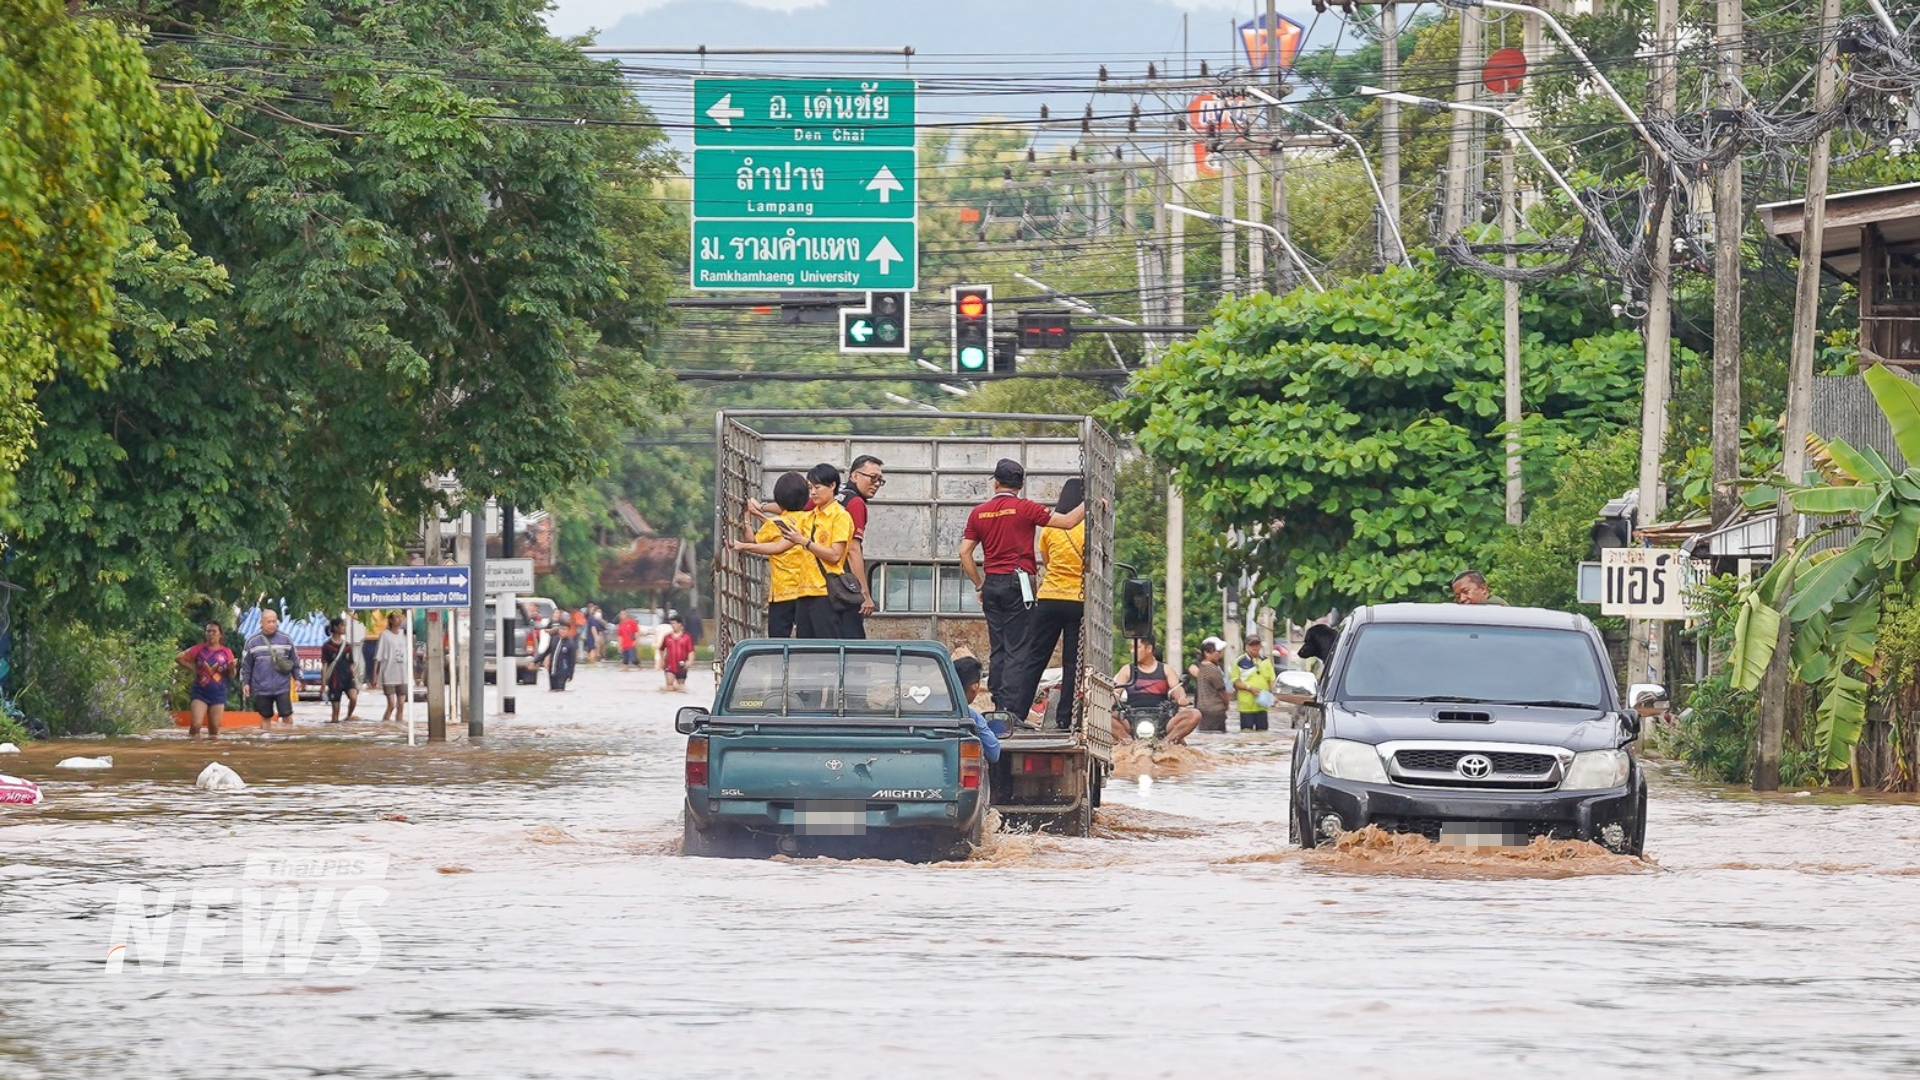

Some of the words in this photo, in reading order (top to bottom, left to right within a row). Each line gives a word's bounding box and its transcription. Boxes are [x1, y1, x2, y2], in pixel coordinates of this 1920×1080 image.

[769, 95, 792, 119] อ.
[804, 82, 890, 119] เด่นชัย
[794, 128, 822, 141] Den
[832, 128, 865, 141] Chai
[737, 157, 824, 191] ลำปาง
[747, 200, 814, 215] Lampang
[700, 235, 725, 260] ม.
[729, 228, 860, 260] รามคำแหง
[700, 269, 795, 285] Ramkhamhaeng
[800, 269, 860, 285] University
[1607, 554, 1671, 605] แอร์
[402, 592, 421, 602] Social
[422, 592, 447, 603] Security
[448, 591, 467, 602] Office
[721, 788, 744, 796] SGL
